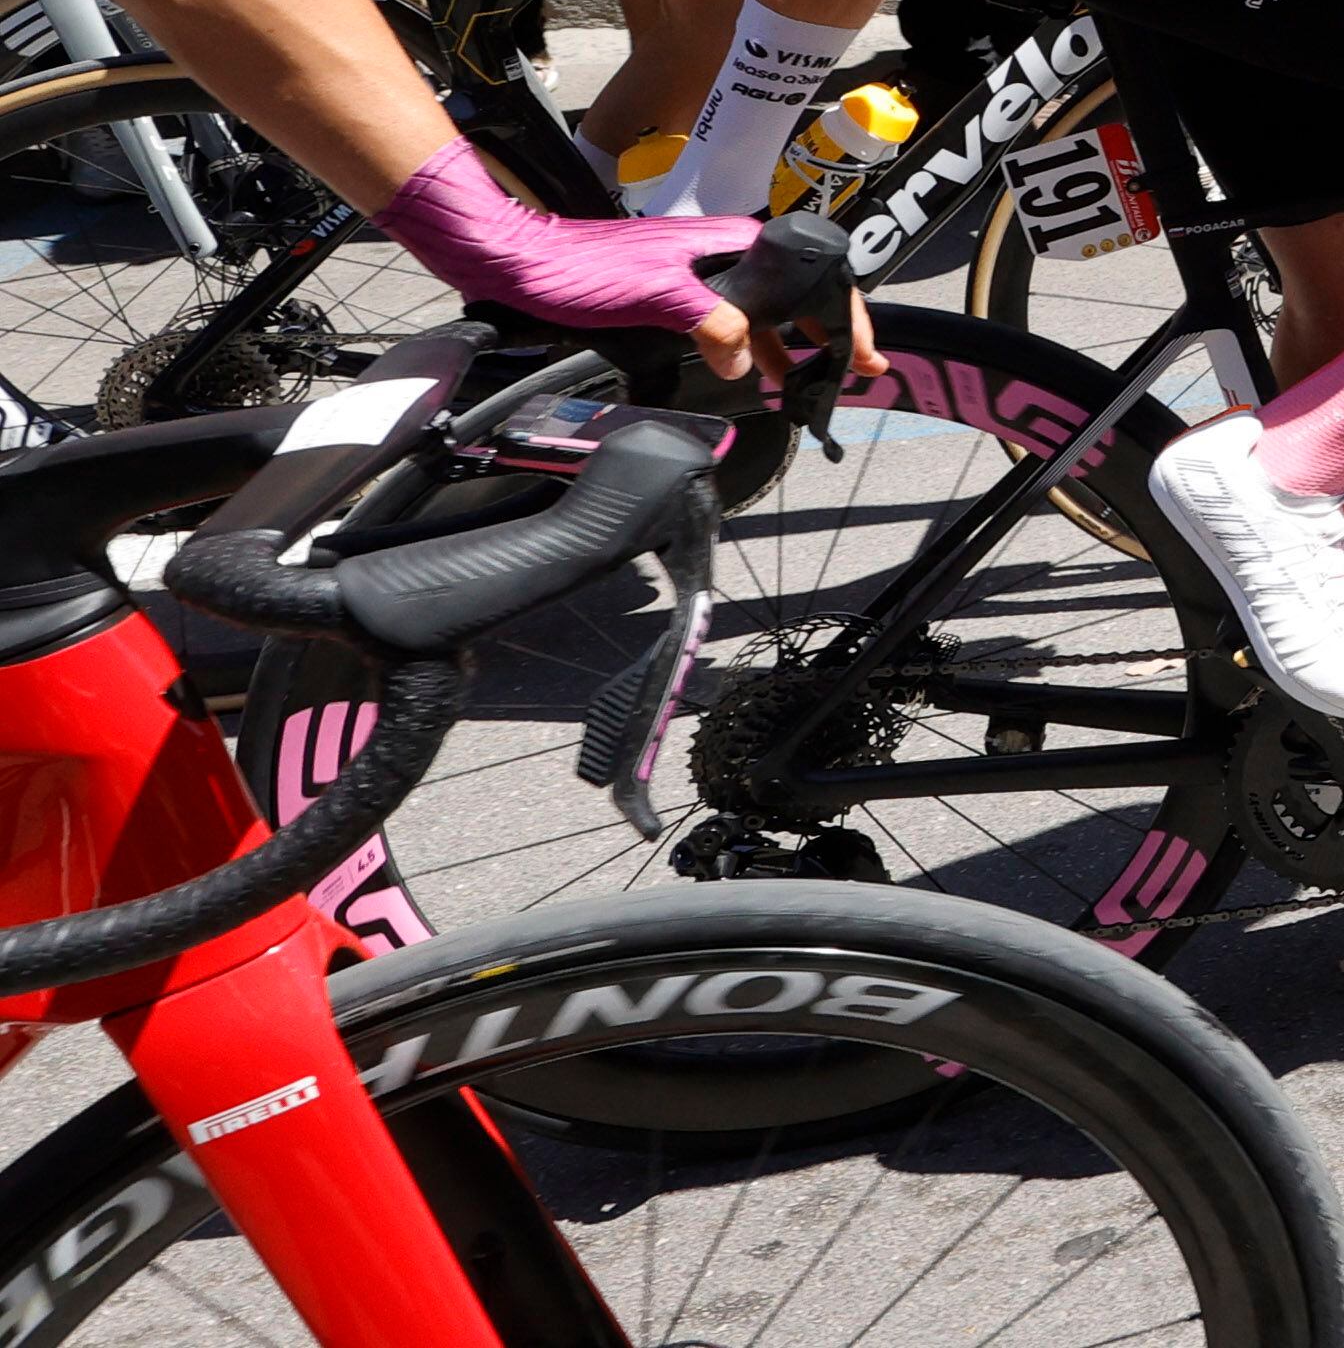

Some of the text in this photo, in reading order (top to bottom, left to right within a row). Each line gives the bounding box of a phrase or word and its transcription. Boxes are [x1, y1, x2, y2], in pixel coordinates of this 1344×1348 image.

[695, 88, 724, 143] nimbl
[1006, 138, 1123, 255] 191
[357, 850, 376, 874] 4.5
[187, 1074, 320, 1144] PIRELLI
